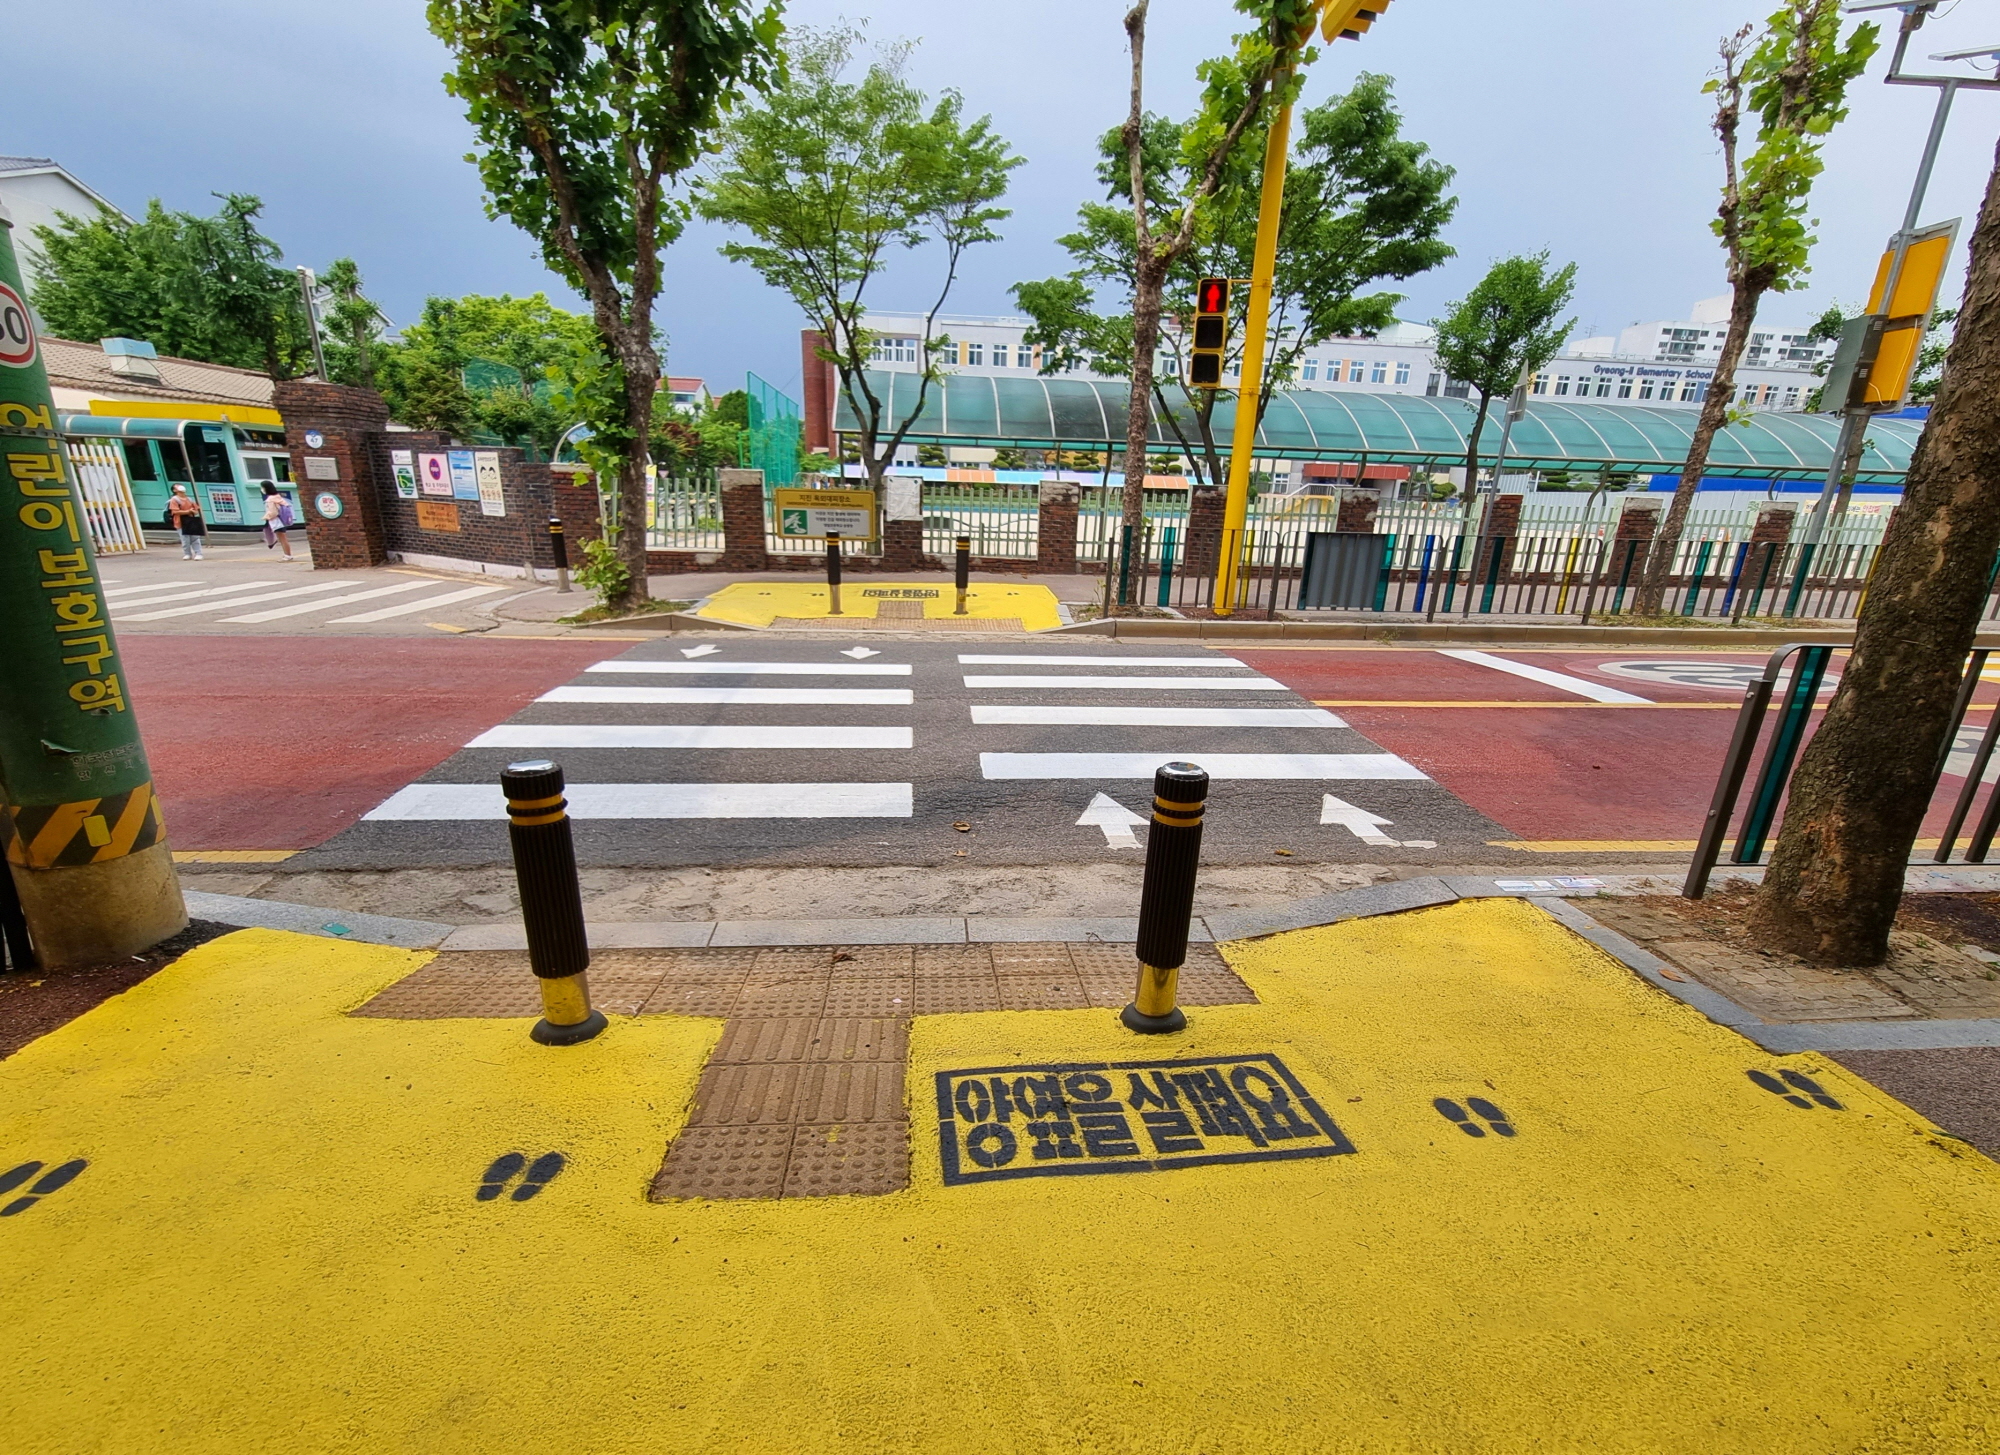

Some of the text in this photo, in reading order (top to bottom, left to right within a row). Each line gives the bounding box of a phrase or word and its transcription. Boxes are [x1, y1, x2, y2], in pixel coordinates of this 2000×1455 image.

[0, 306, 28, 345] 0
[1636, 366, 1683, 380] Elementary
[1685, 369, 1713, 379] School
